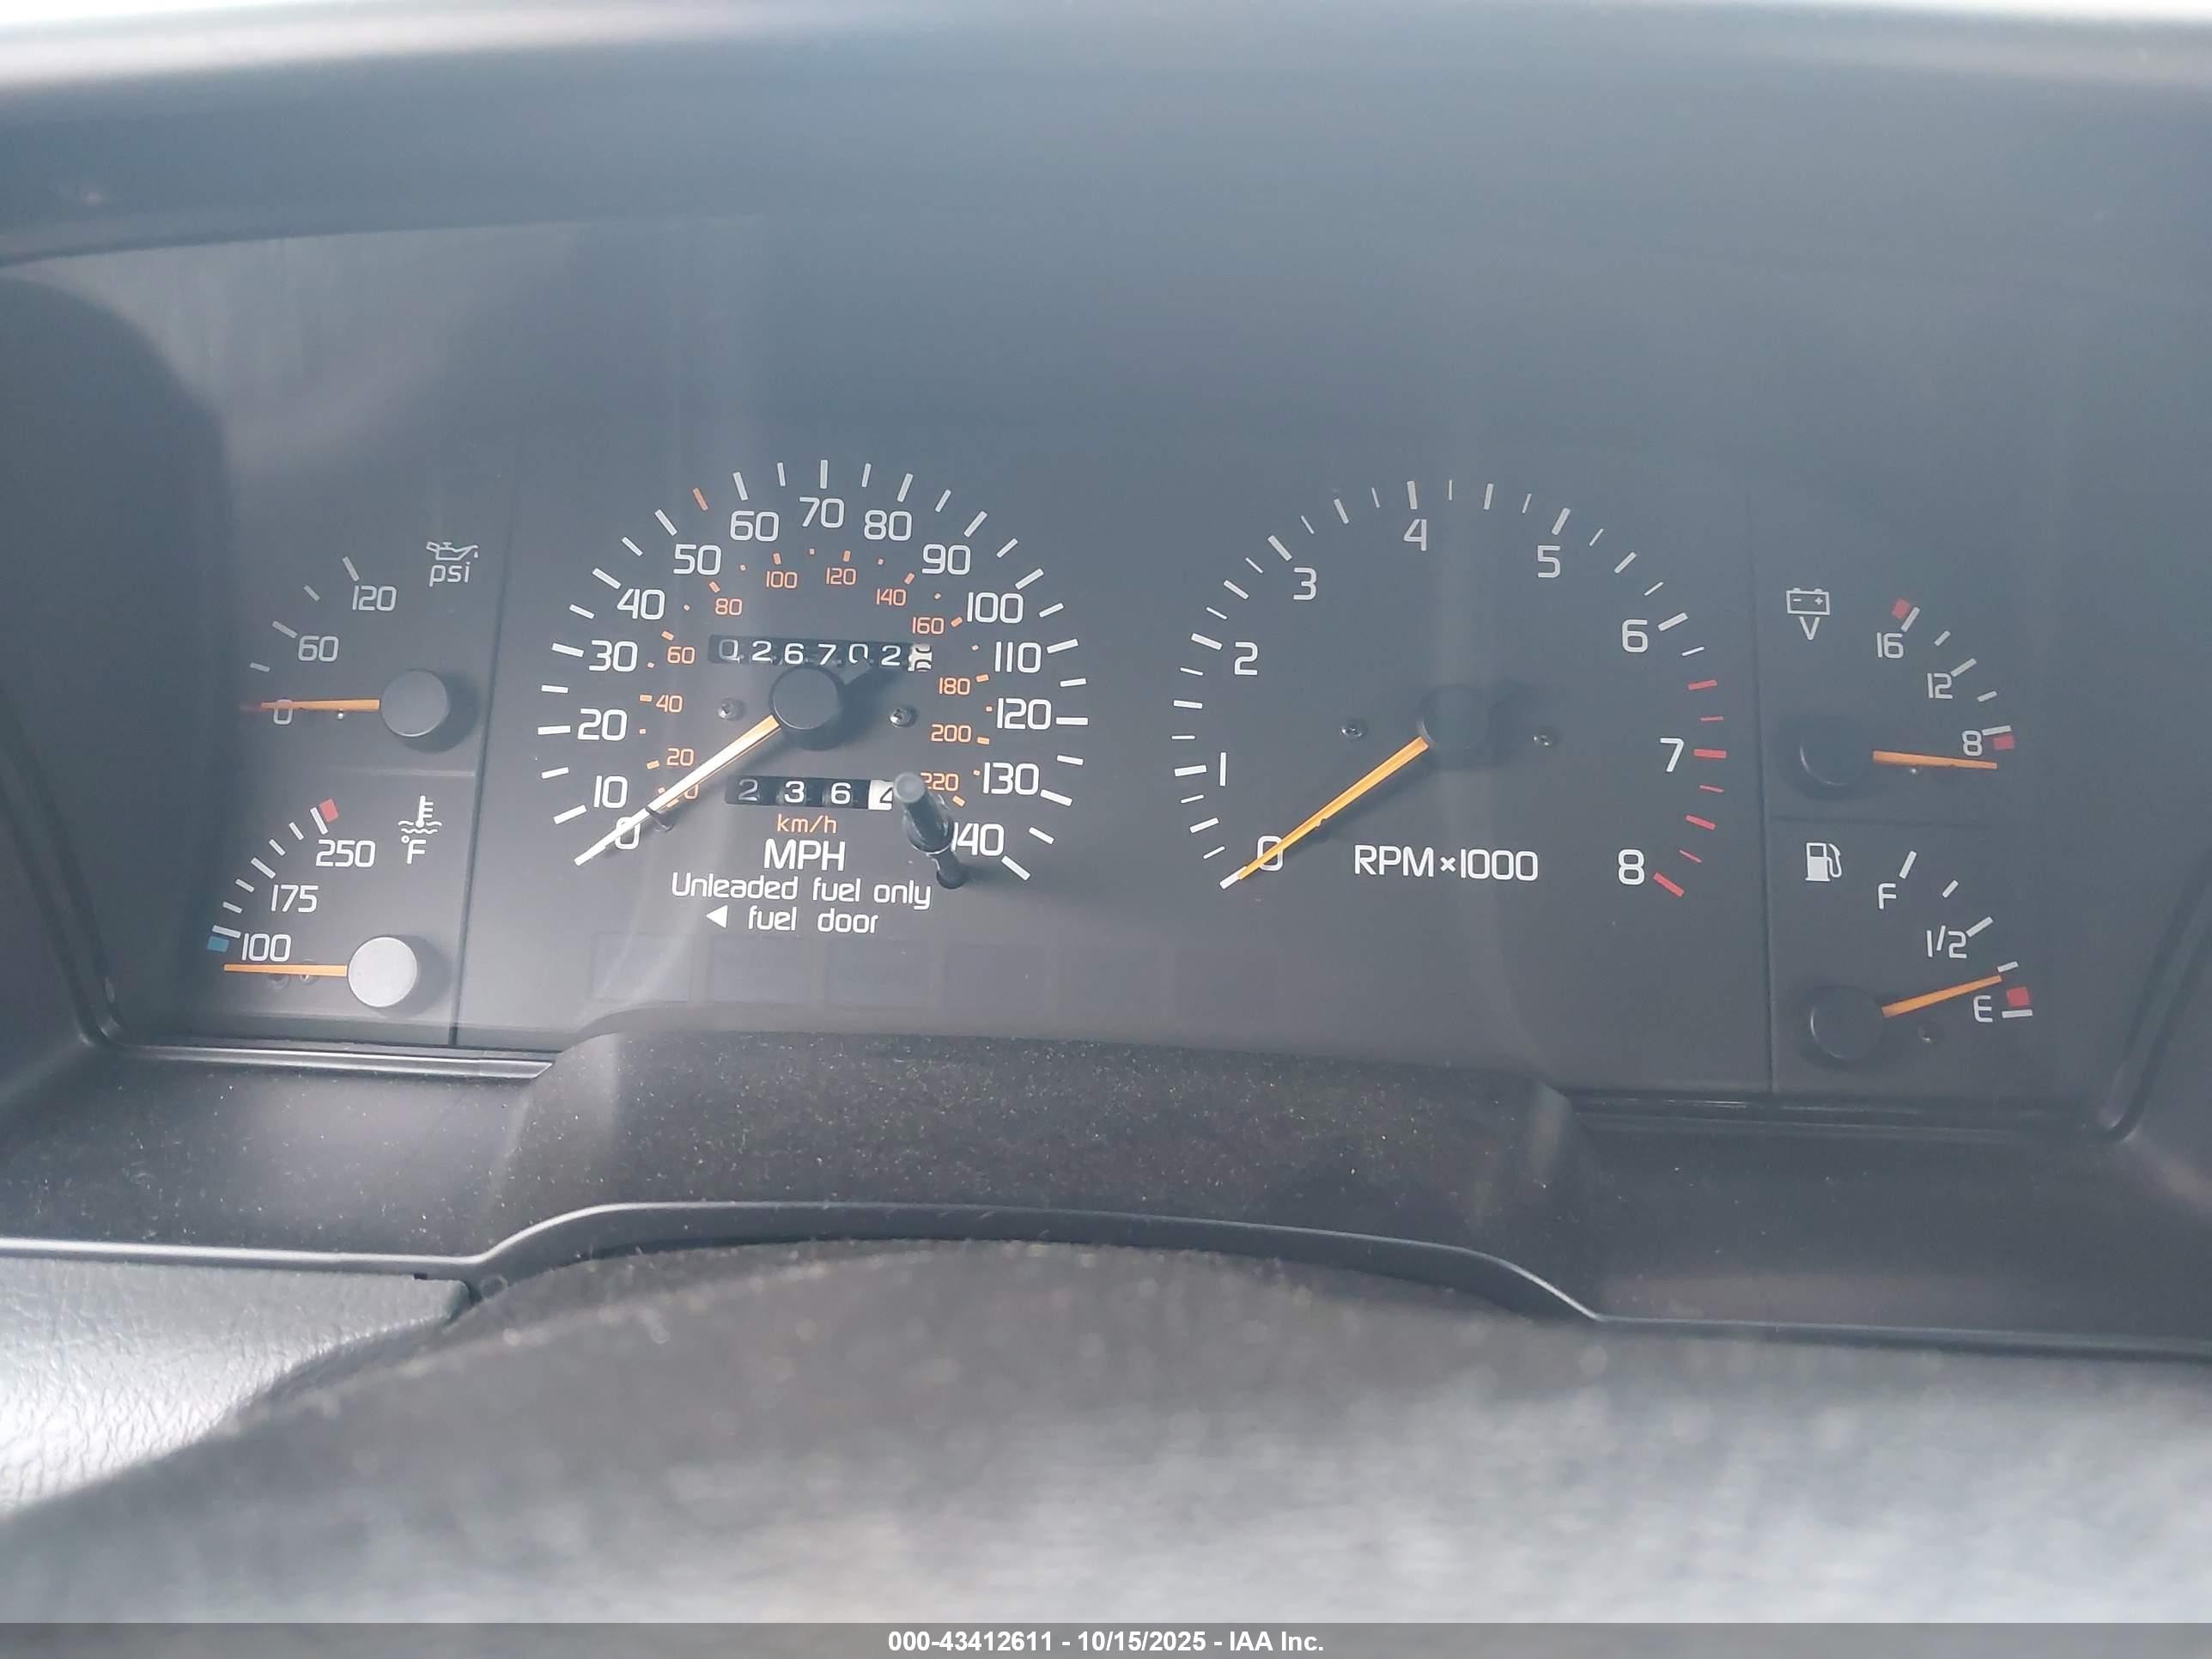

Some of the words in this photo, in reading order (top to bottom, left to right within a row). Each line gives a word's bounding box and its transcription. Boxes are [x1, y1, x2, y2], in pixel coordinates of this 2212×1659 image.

[730, 510, 780, 542] 60
[799, 496, 845, 529] 70
[863, 509, 913, 541] 80
[1403, 519, 1428, 552] 4
[429, 562, 471, 587] psi
[673, 543, 722, 576] 50
[921, 543, 971, 575] 90
[1537, 544, 1561, 578] 5
[765, 570, 798, 589] 100
[825, 567, 857, 586] 120
[1293, 567, 1318, 601] 3
[352, 585, 398, 611] 120
[617, 588, 665, 620] 40
[714, 598, 743, 616] 80
[876, 588, 907, 606] 140
[966, 591, 1024, 623] 100
[911, 616, 945, 635] 160
[1621, 618, 1650, 653] 6
[1799, 616, 1820, 641] V
[297, 635, 339, 662] 60
[588, 639, 639, 672] 30
[666, 646, 696, 665] 60
[994, 641, 1042, 674] 110
[1234, 641, 1258, 677] 2
[1876, 632, 1905, 659] 16
[938, 677, 971, 696] 180
[1927, 672, 1954, 699] 12
[273, 699, 293, 725] 0
[656, 695, 684, 713] 40
[996, 697, 1052, 730] 120
[577, 708, 628, 741] 20
[930, 724, 972, 743] 200
[666, 748, 695, 767] 20
[1659, 738, 1685, 773] 7
[1961, 729, 1983, 757] 8
[593, 775, 629, 809] 10
[921, 772, 959, 792] 220
[982, 762, 1040, 795] 130
[614, 817, 641, 849] 0
[776, 813, 838, 835] km/h
[950, 822, 1005, 856] 140
[315, 839, 376, 868] 250
[763, 838, 847, 872] MPH
[1256, 836, 1284, 872] 0
[1618, 848, 1645, 885] 8
[270, 884, 319, 913] 175
[671, 872, 799, 902] Unleaded
[811, 876, 861, 902] fuel
[872, 879, 932, 910] only
[1876, 882, 1897, 910] F
[747, 905, 798, 932] fuel
[817, 907, 879, 934] door
[241, 933, 292, 963] 100
[1925, 925, 1968, 959] 1/2
[1972, 994, 1994, 1024] E
